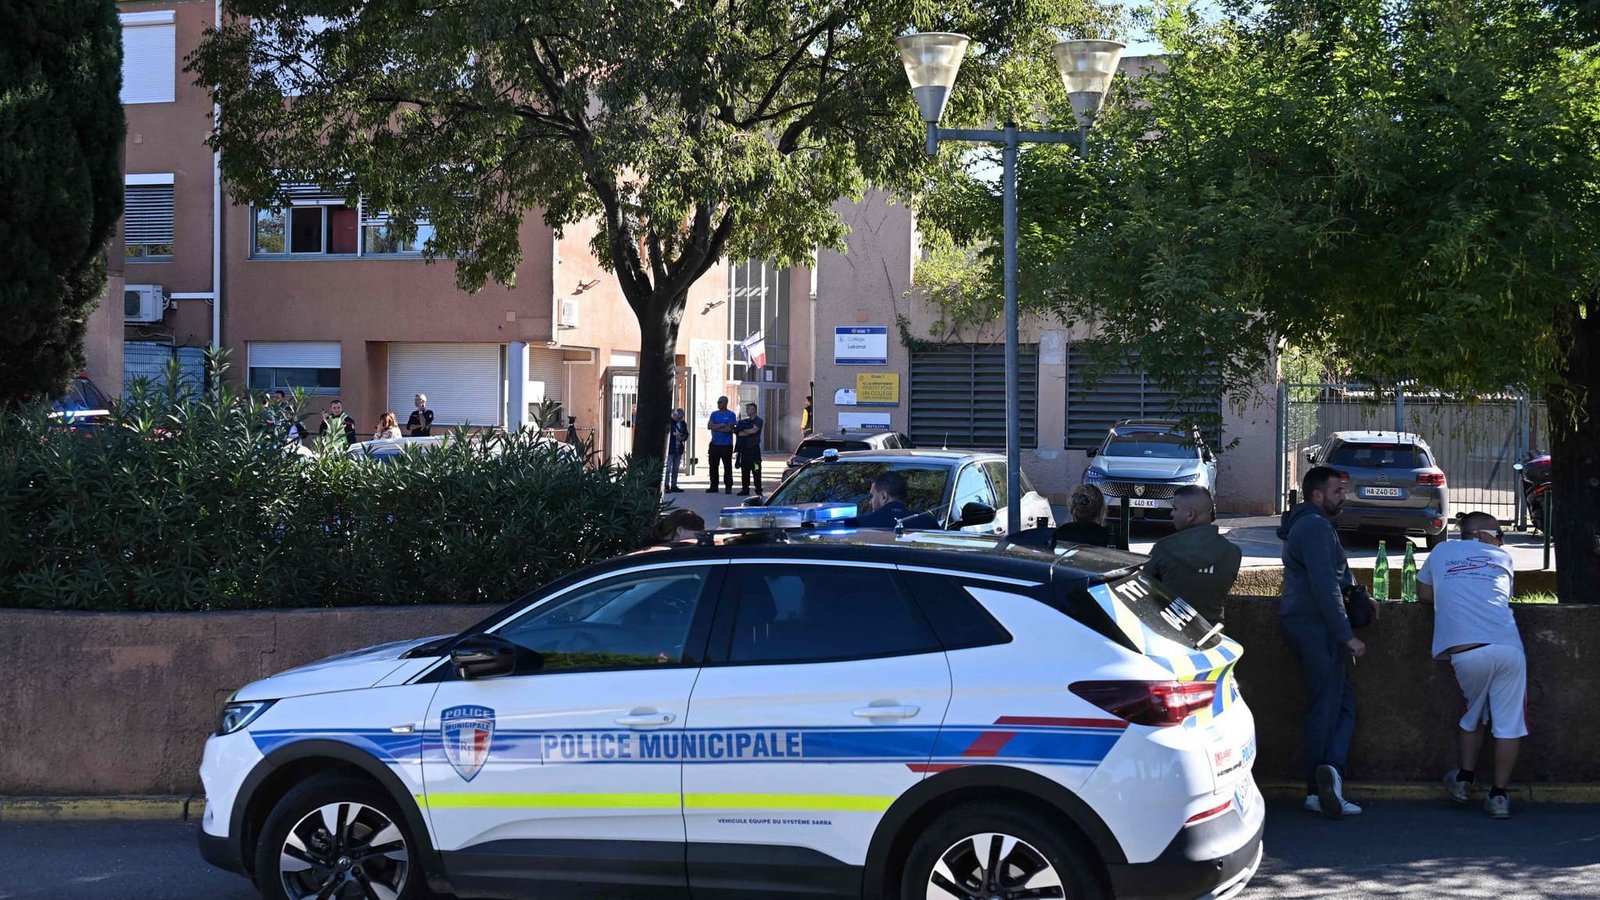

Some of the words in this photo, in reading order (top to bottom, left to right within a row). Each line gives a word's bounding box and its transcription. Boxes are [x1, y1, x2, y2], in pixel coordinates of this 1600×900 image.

[445, 708, 491, 719] POLICE
[445, 722, 490, 731] MUNICIPALE
[544, 733, 632, 760] POLICE
[639, 732, 801, 760] MUNICIPALE
